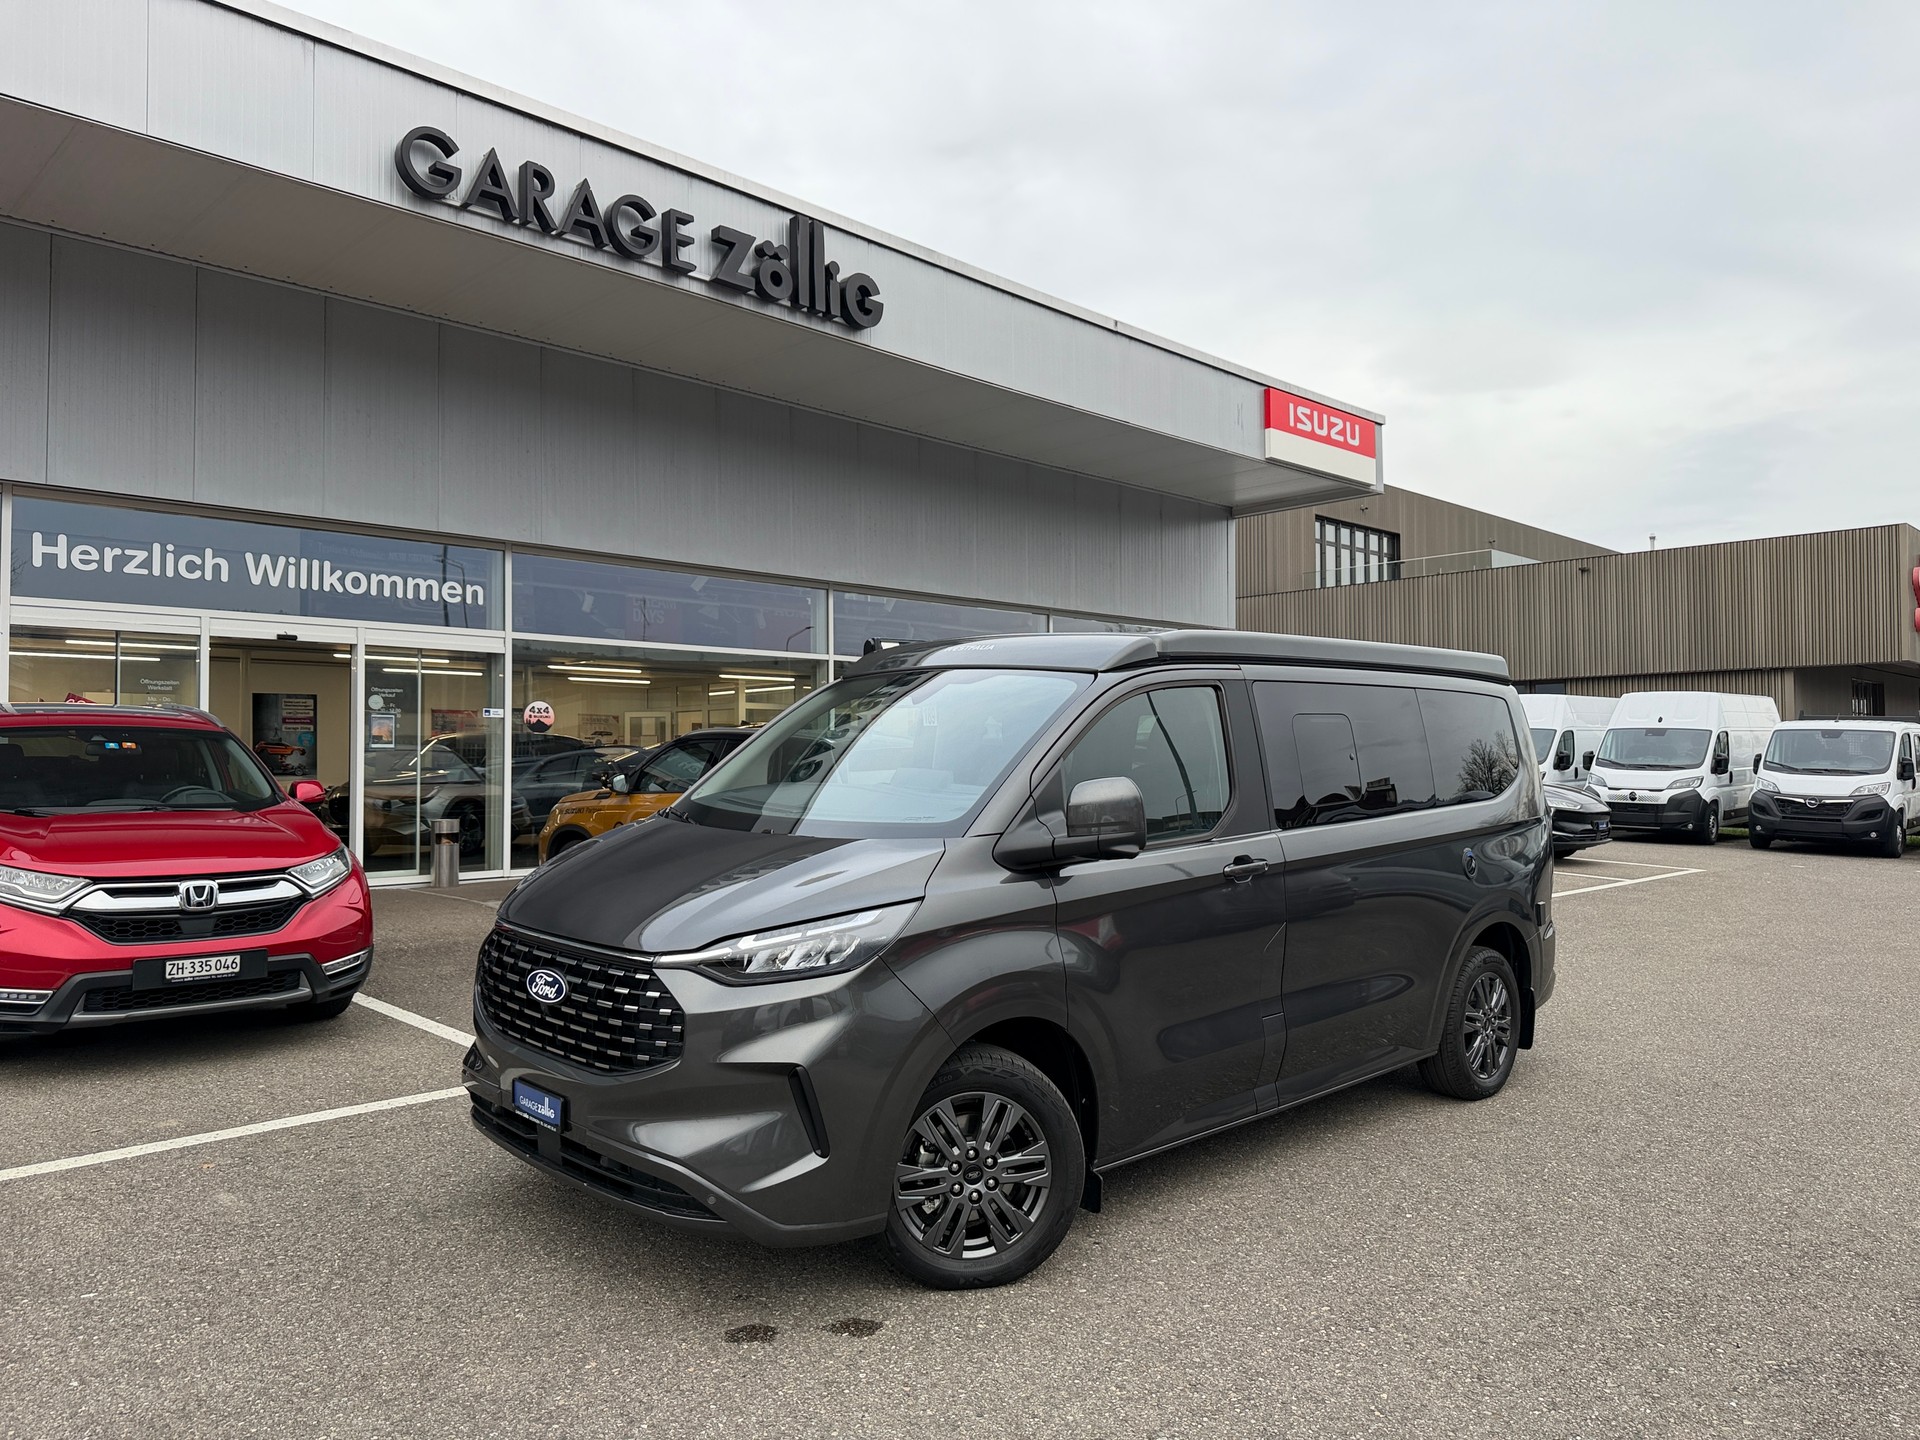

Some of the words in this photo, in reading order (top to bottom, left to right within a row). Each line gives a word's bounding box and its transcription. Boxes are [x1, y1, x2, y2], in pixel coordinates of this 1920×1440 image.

[395, 126, 697, 275] GARAGE
[1288, 402, 1360, 447] ISUZU
[31, 531, 230, 583] Herzlich
[244, 552, 485, 606] Willkommen
[528, 705, 550, 715] 4x4
[214, 957, 239, 972] 046
[532, 973, 559, 999] Ford
